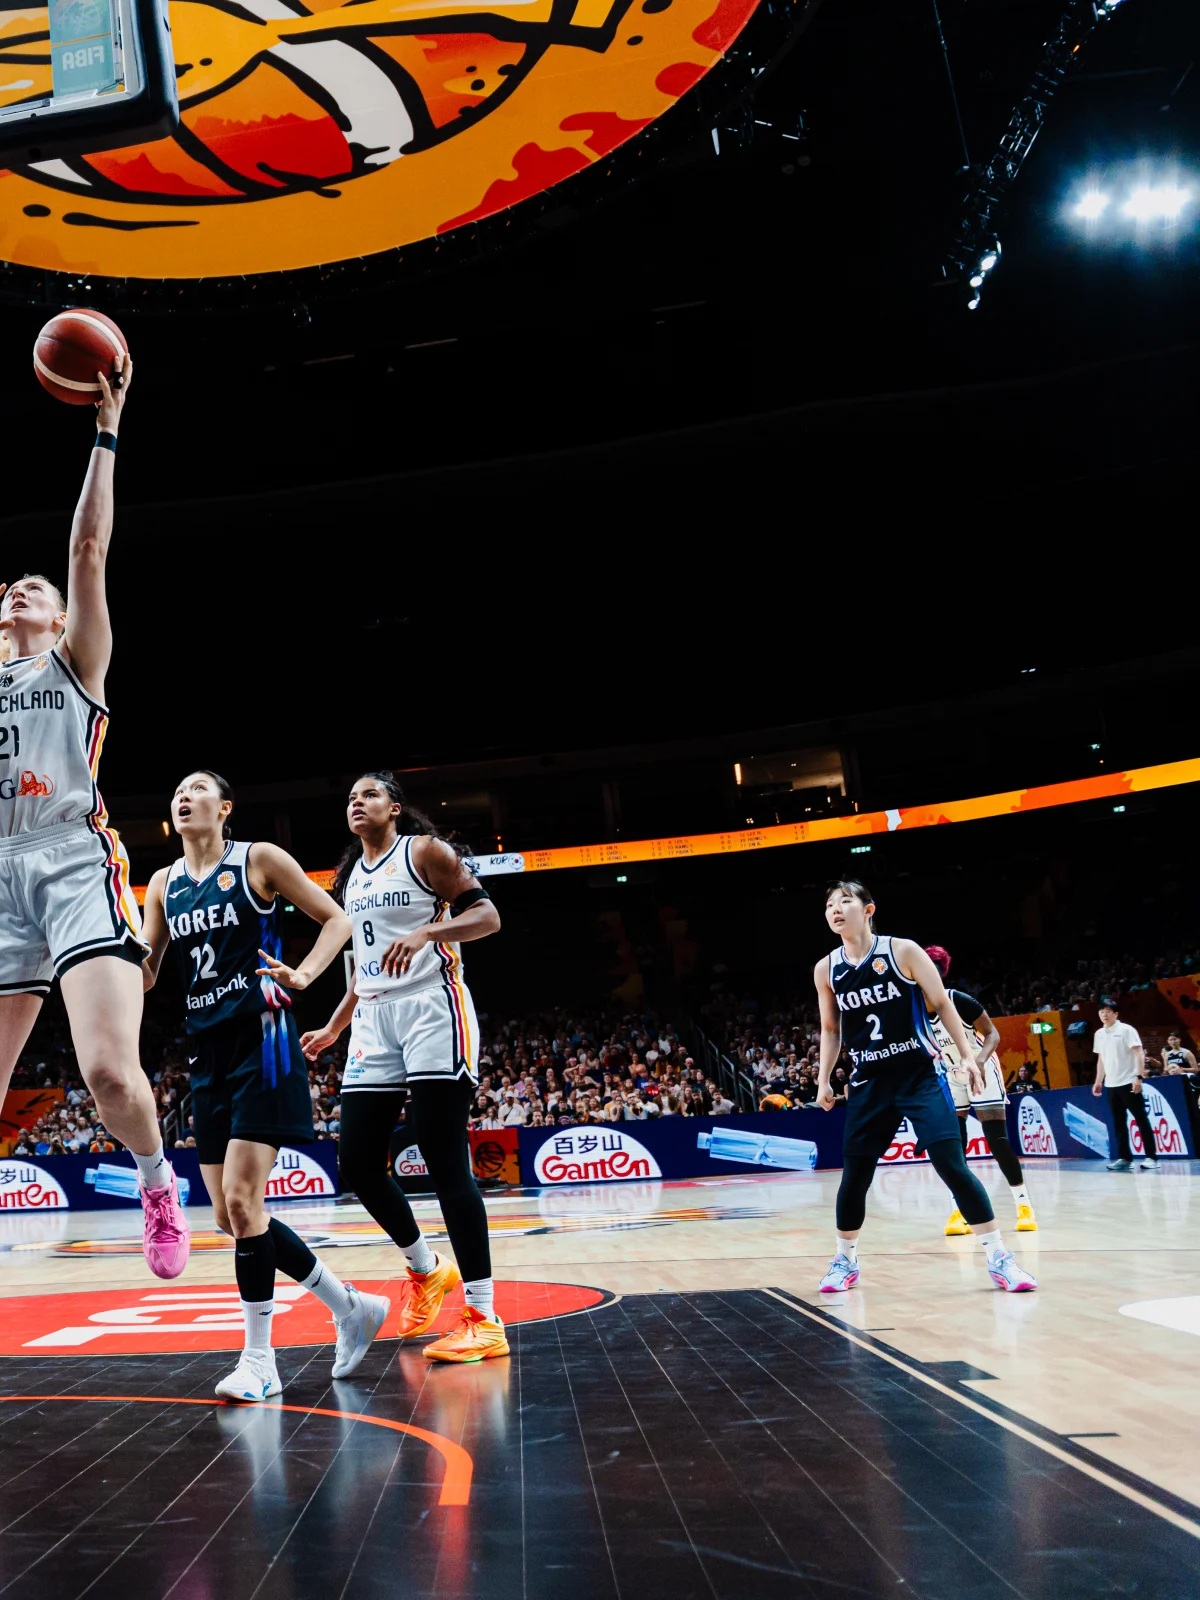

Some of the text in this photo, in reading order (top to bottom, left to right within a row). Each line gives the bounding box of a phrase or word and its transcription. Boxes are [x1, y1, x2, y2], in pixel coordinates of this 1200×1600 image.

[490, 855, 508, 865] KOR
[168, 902, 239, 940] KOREA
[362, 920, 375, 946] 8
[190, 943, 218, 981] 12
[360, 960, 380, 979] NG
[836, 981, 901, 1011] KOREA
[865, 1014, 883, 1040] 2
[861, 1038, 921, 1062] Hana Bank
[554, 1134, 622, 1155] 百岁山
[1129, 1117, 1182, 1153] Gten
[264, 1170, 324, 1196] nten
